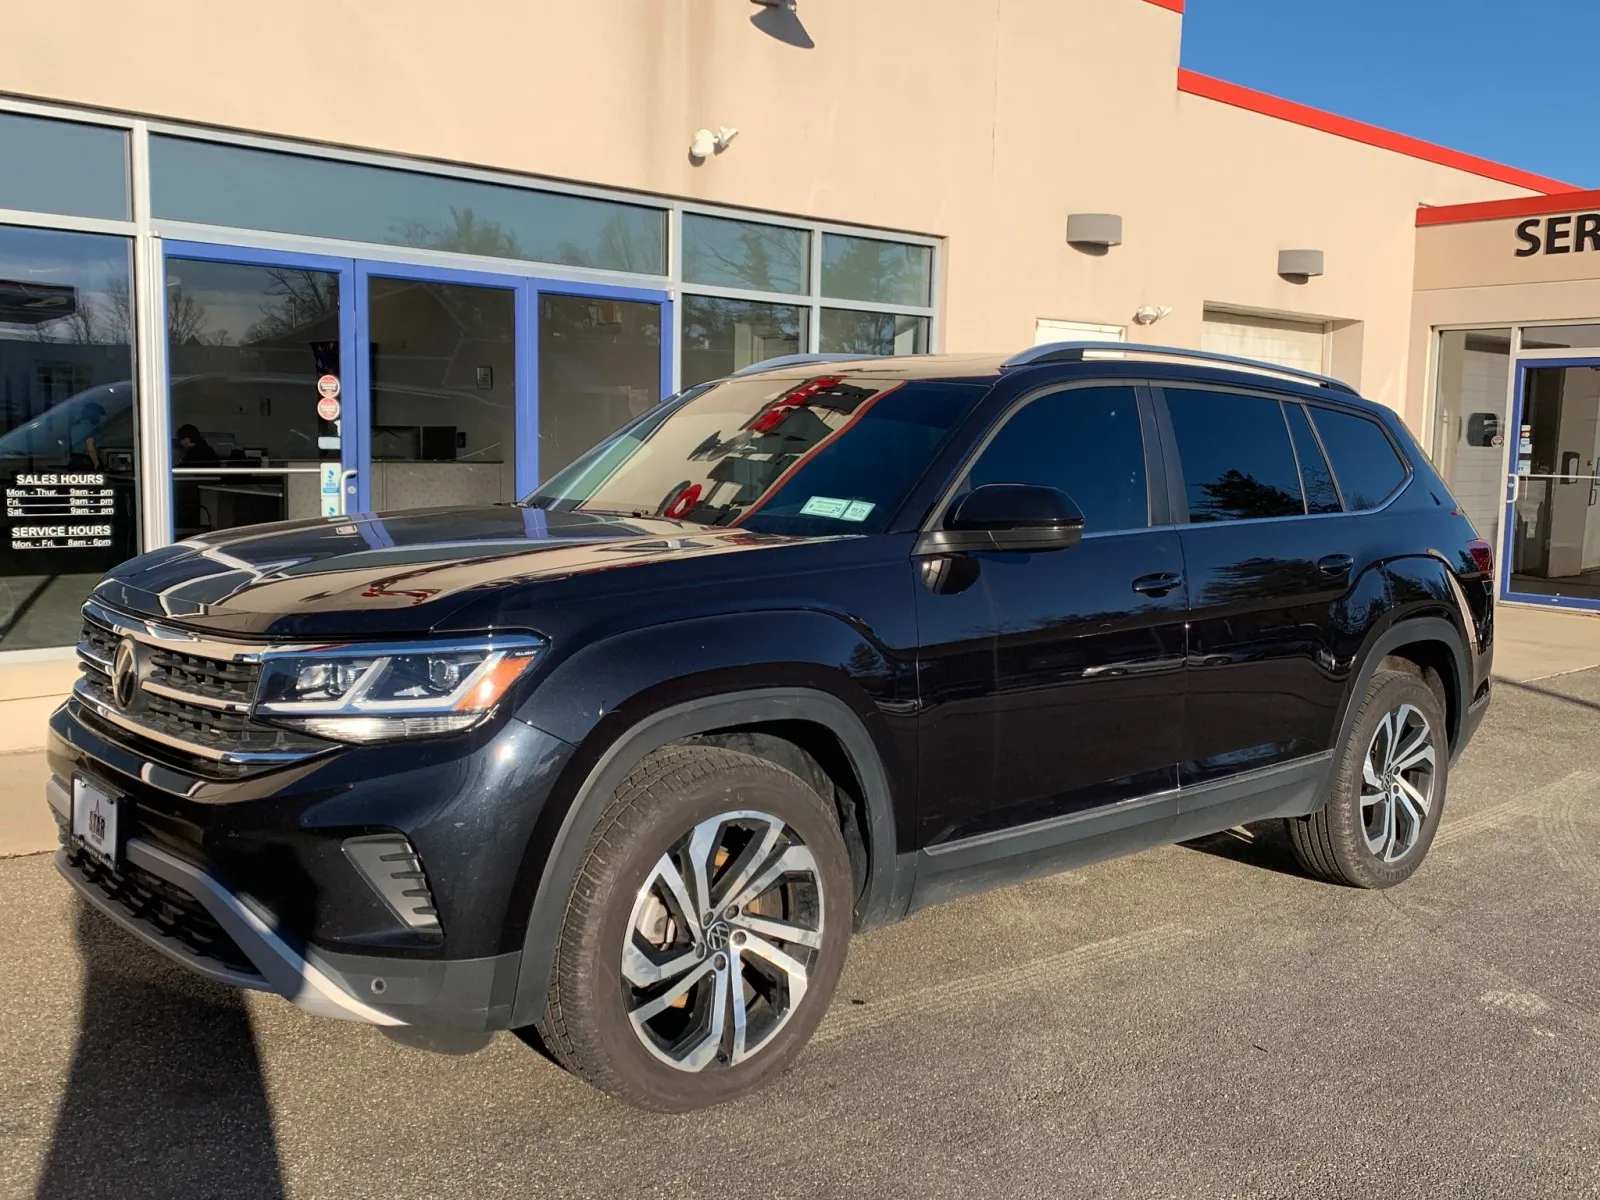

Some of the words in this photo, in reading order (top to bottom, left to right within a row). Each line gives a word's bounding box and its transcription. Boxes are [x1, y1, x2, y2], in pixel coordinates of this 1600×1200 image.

[1514, 213, 1600, 257] SER
[16, 474, 57, 485] SALES
[60, 474, 104, 485] HOURS
[6, 488, 28, 496] Mon.
[36, 488, 58, 496] Thur.
[69, 488, 88, 496] 9am
[6, 498, 21, 506] Fri.
[69, 497, 88, 505] 9am
[7, 508, 24, 516] Sat.
[70, 507, 88, 515] 9am
[12, 526, 65, 537] SERVICE
[68, 525, 111, 536] HOURS
[12, 540, 34, 549] Mon.
[41, 539, 55, 547] Fri.
[67, 539, 86, 547] 8am
[93, 538, 111, 547] 6pm
[89, 810, 106, 840] STAR
